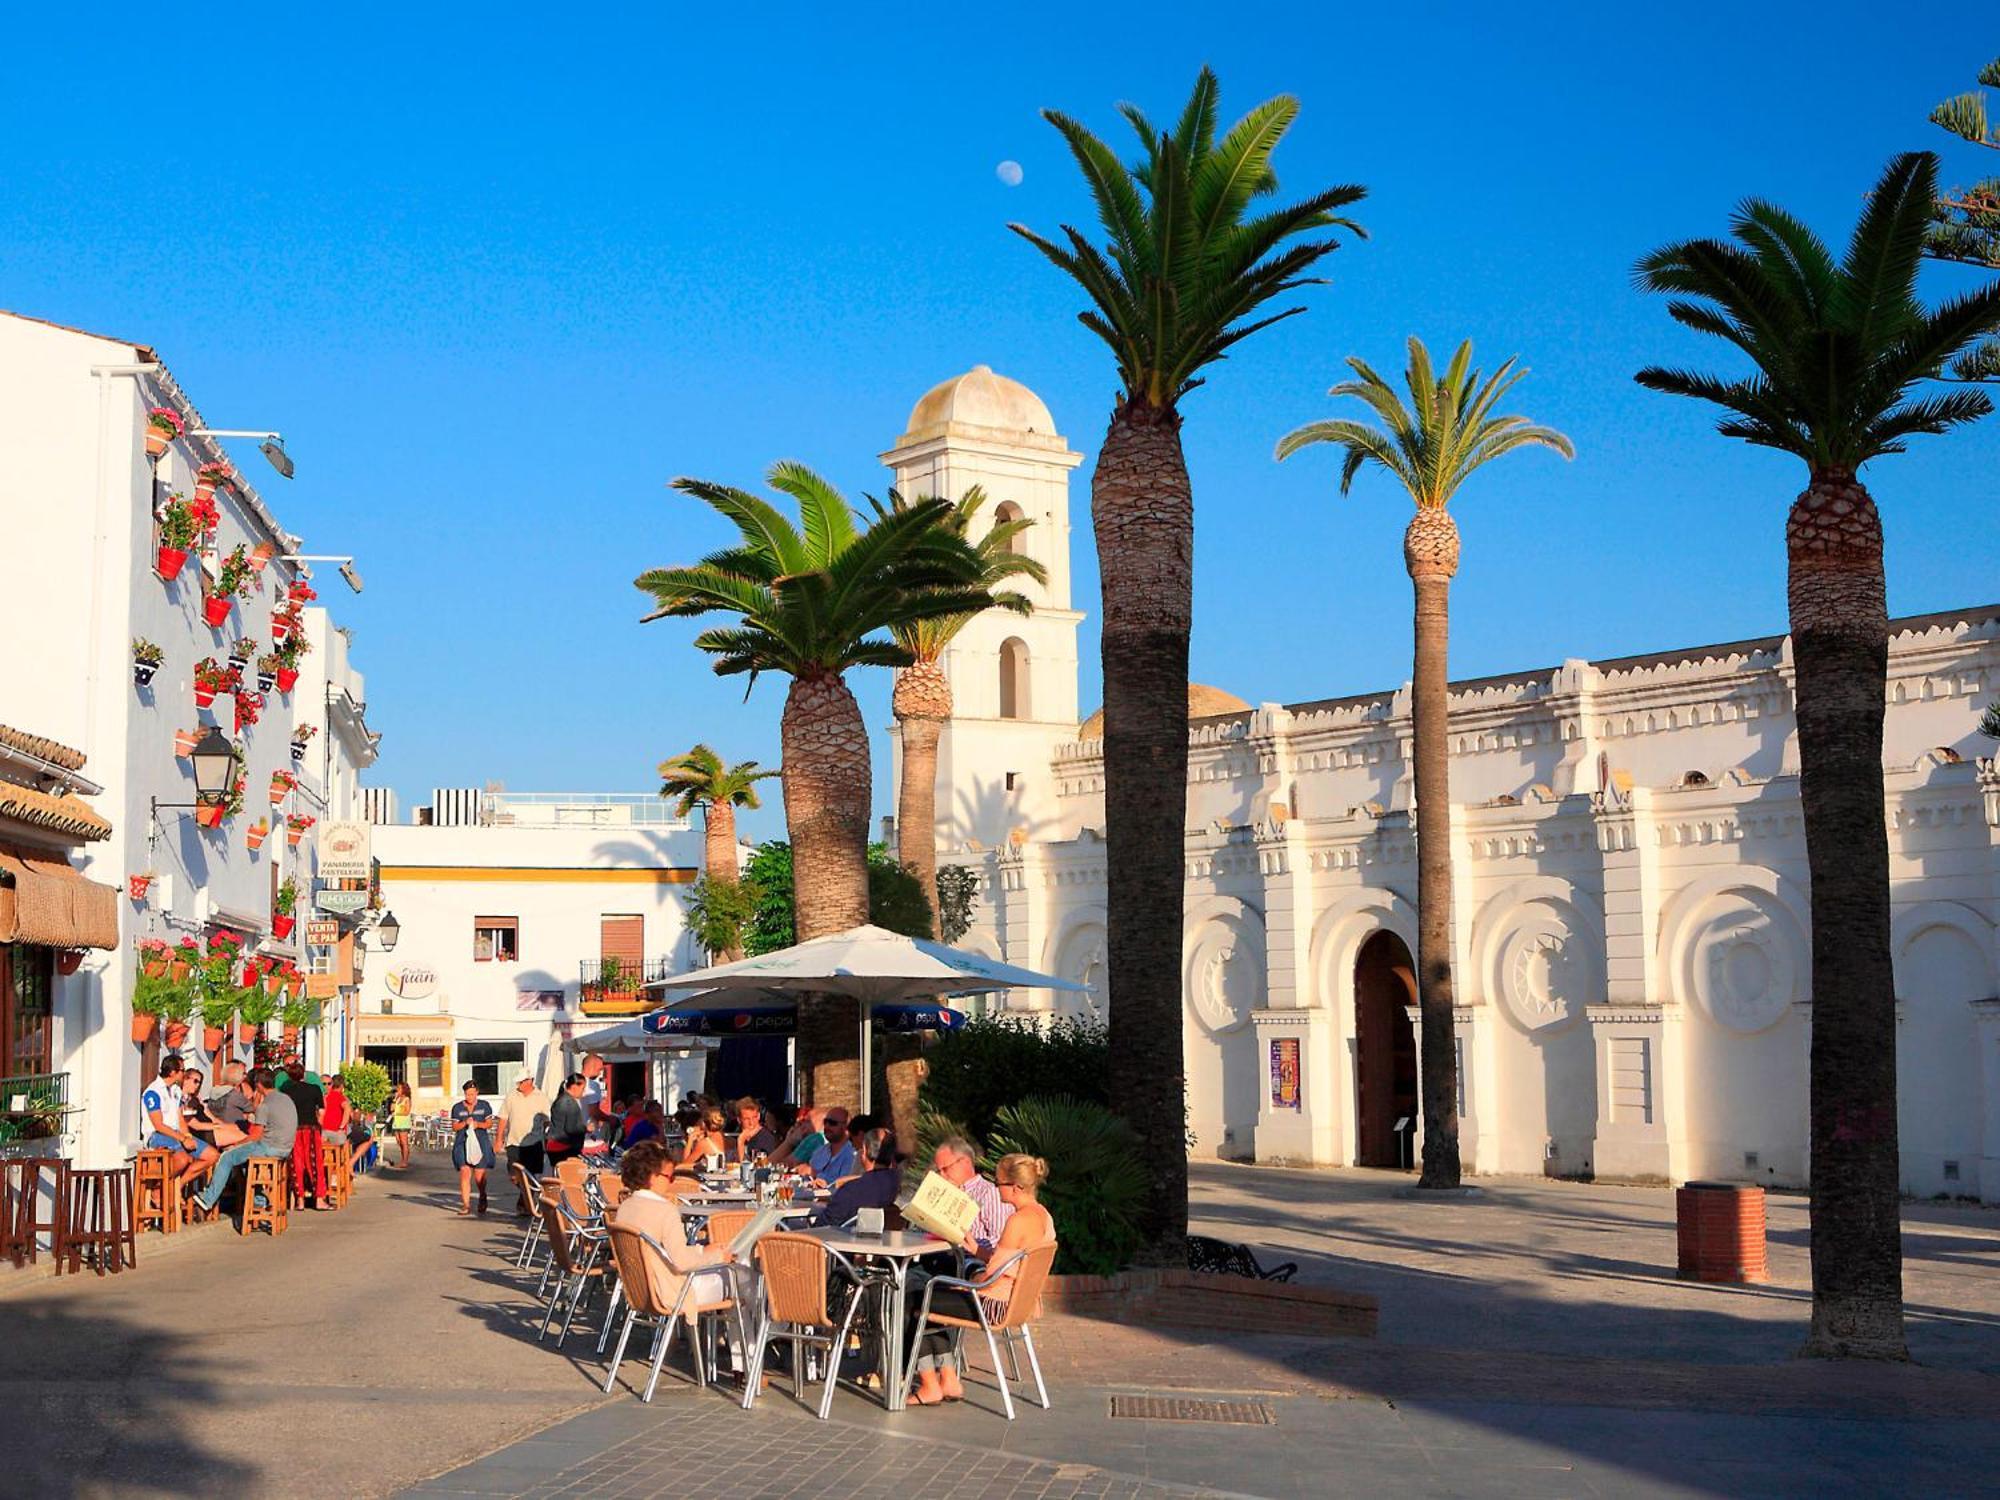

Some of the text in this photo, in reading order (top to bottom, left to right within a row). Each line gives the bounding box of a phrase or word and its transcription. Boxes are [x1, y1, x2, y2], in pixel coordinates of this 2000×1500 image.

[308, 923, 336, 933] VENTA
[308, 934, 320, 943] DE
[668, 1017, 689, 1028] pepsi
[755, 1015, 793, 1028] pepsi
[147, 1097, 156, 1108] 3
